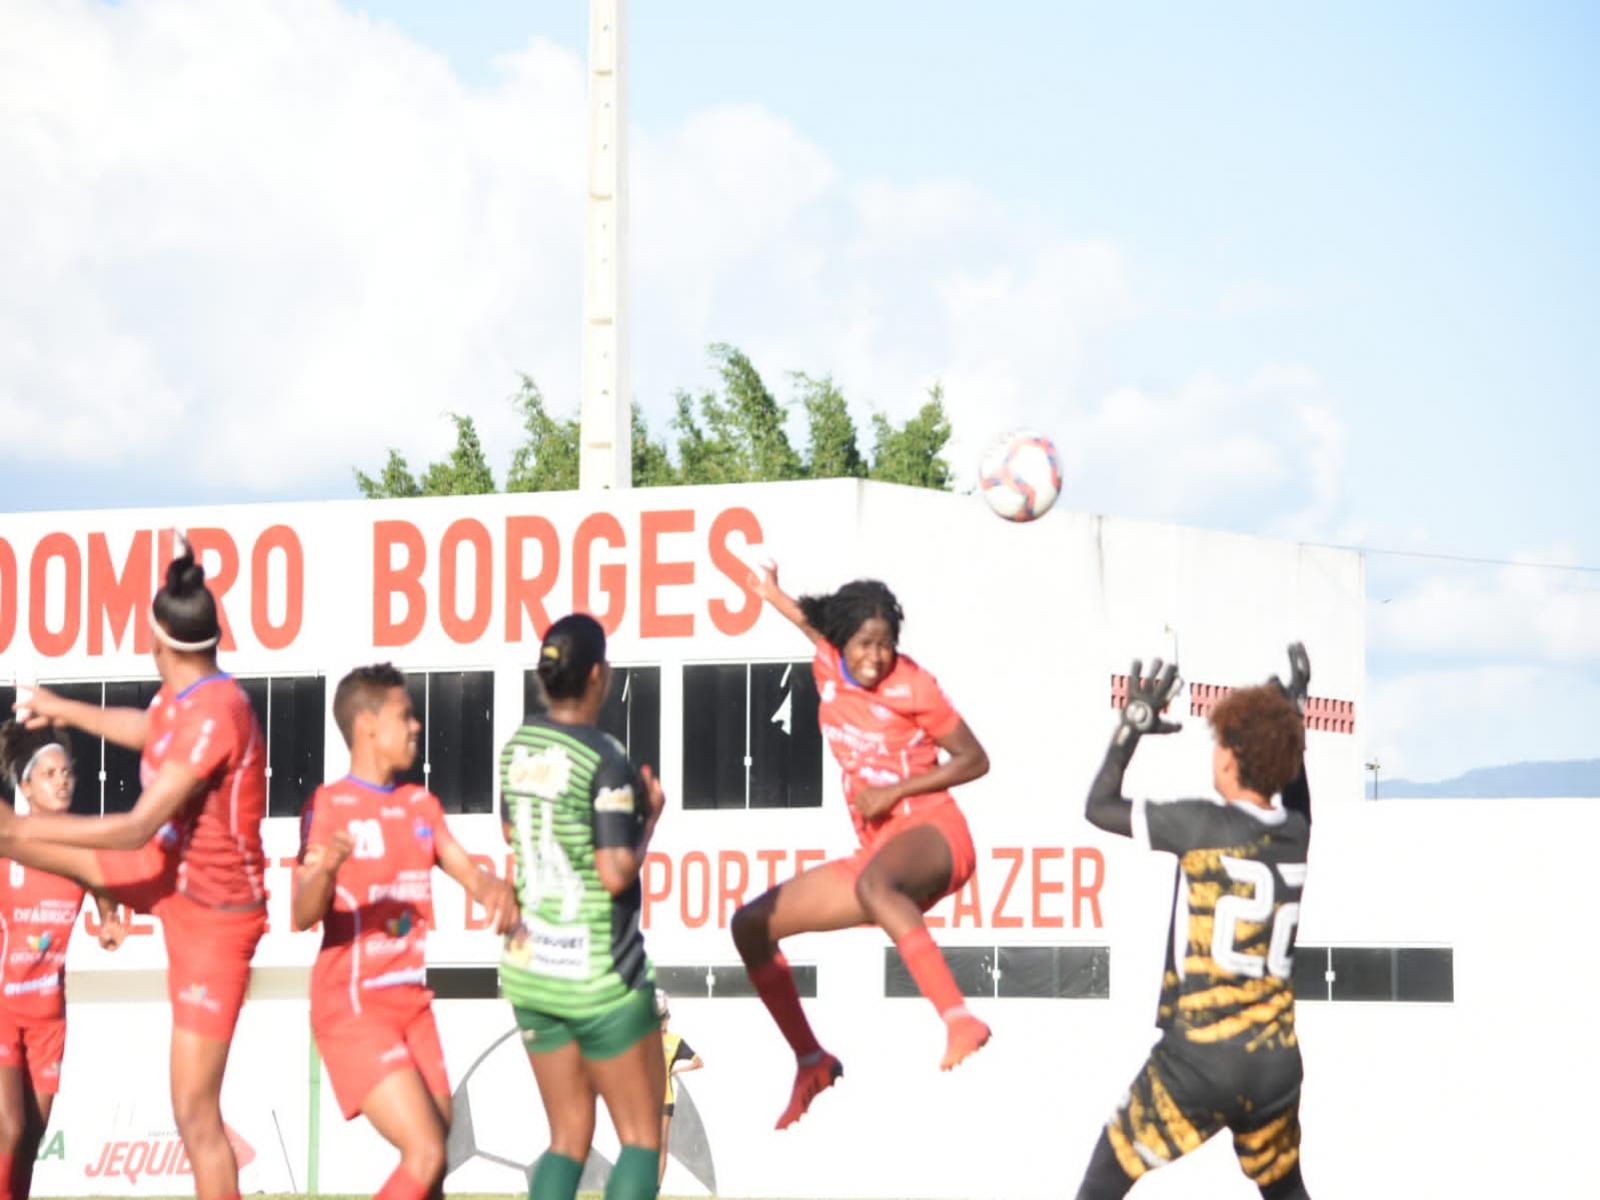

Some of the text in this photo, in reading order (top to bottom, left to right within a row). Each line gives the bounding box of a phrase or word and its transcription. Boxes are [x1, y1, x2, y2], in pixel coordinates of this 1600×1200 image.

[373, 507, 764, 647] BORGES
[642, 849, 826, 930] PORT
[923, 847, 1105, 929] AZER
[1211, 855, 1307, 979] 22
